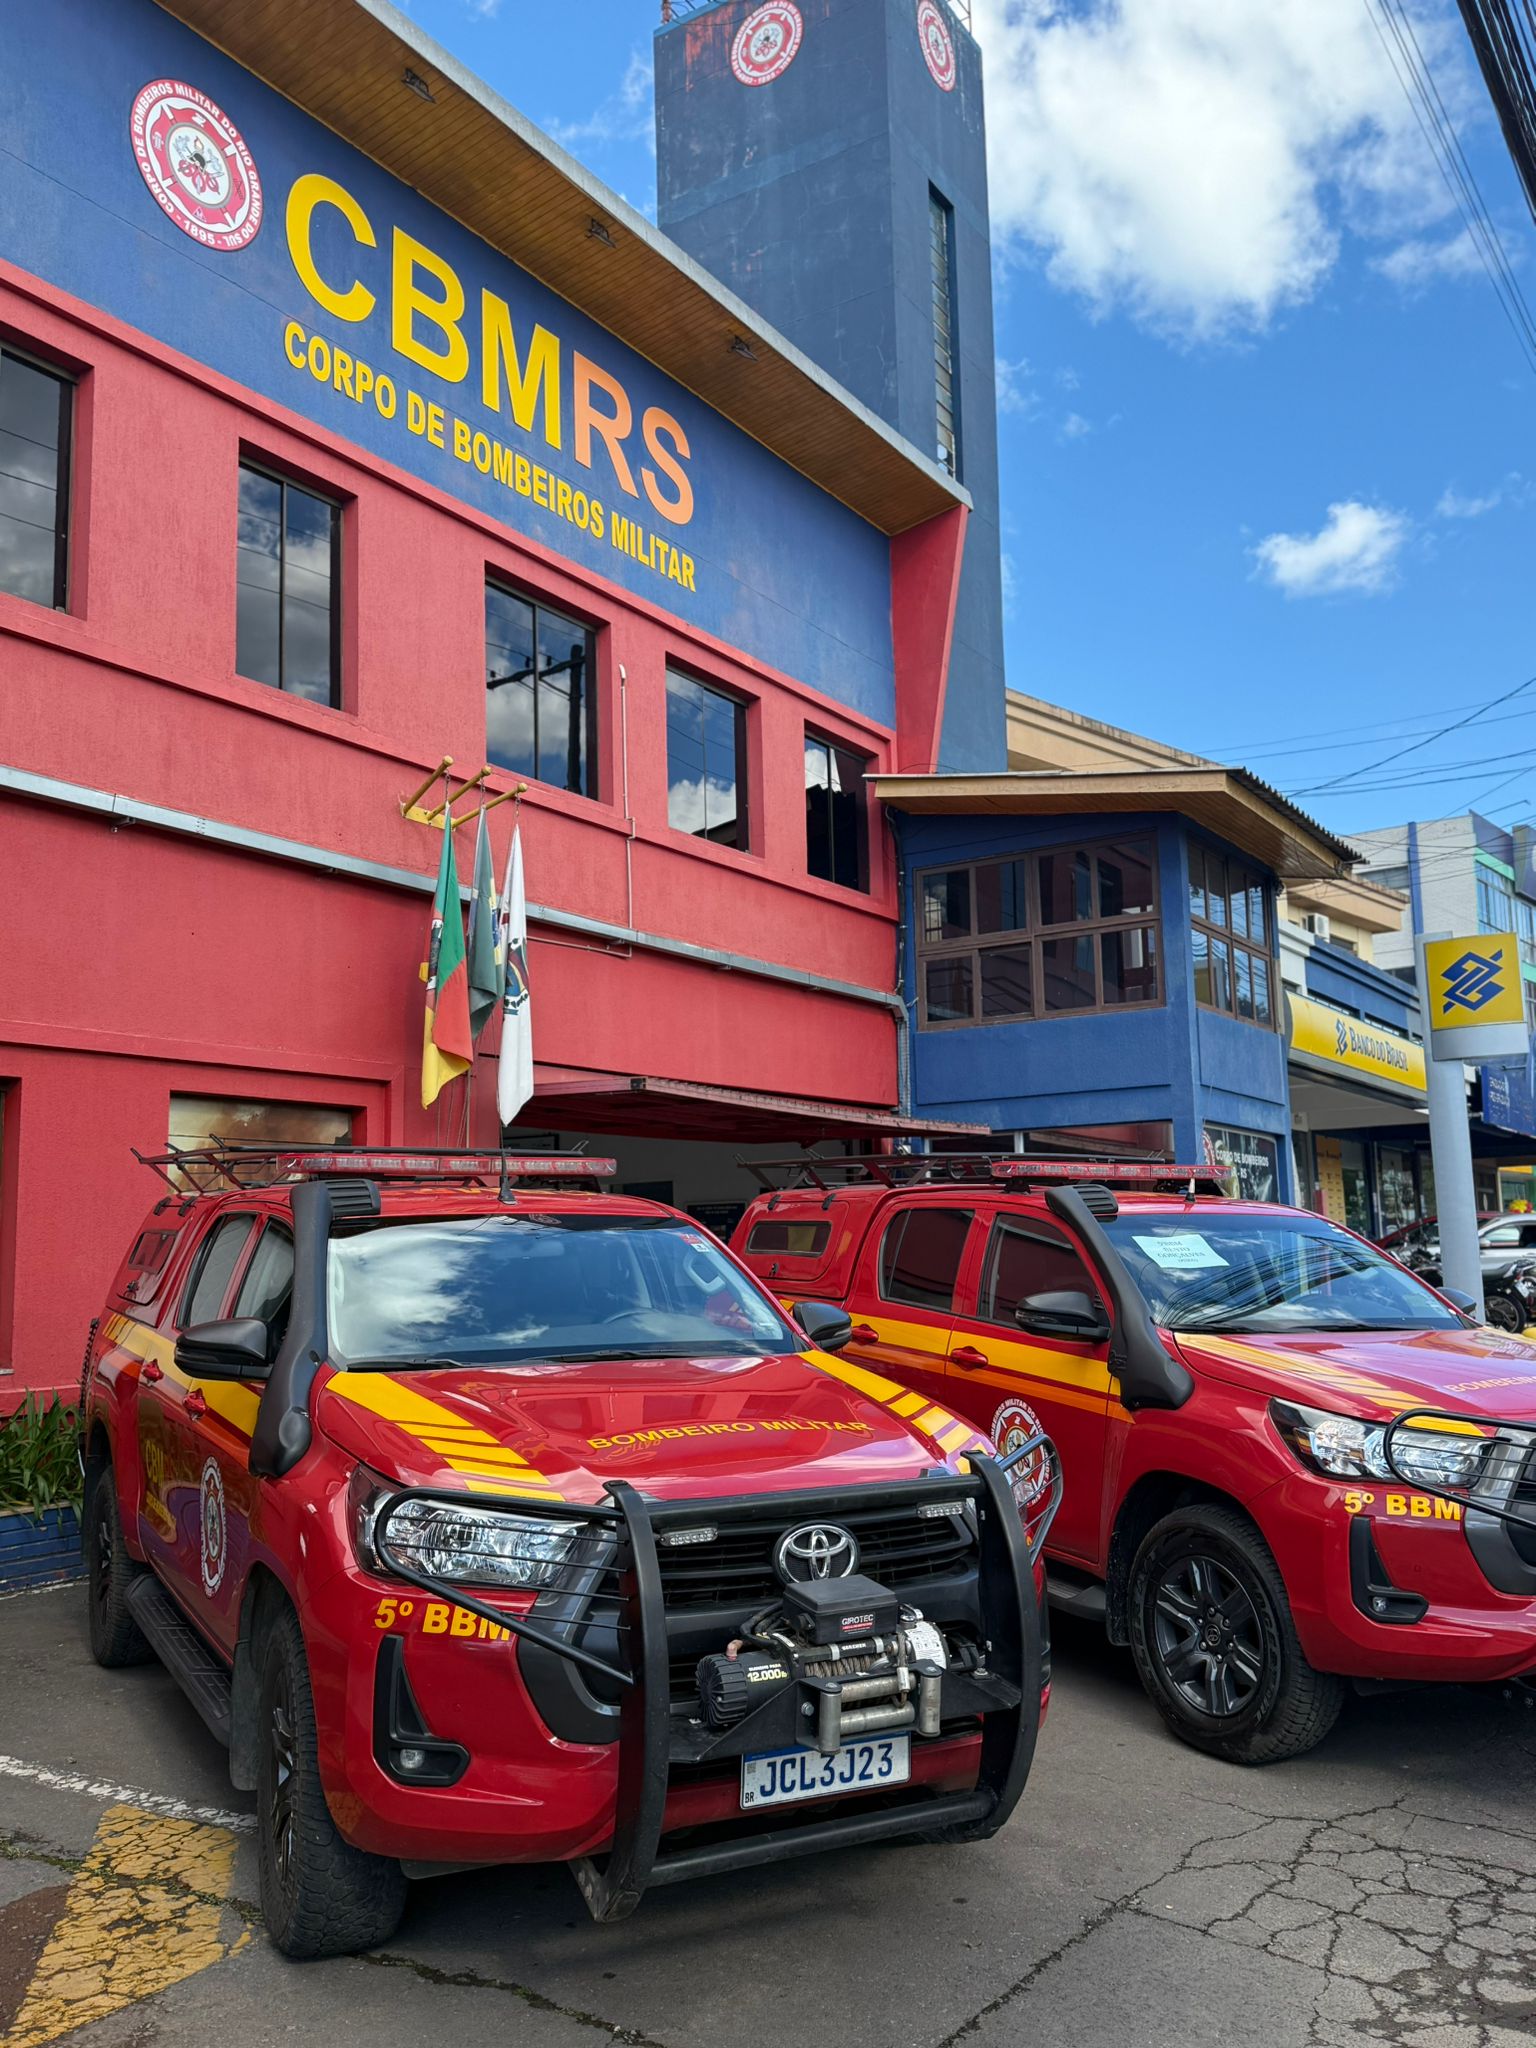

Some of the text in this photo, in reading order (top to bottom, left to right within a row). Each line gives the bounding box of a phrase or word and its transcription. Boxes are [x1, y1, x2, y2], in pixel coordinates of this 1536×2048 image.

[133, 82, 261, 247] CORPO DE BOMBEIROS MILITAR DO RIO GRANDE DO SUL
[183, 220, 215, 245] 1895
[285, 173, 695, 526] CBMRS
[284, 321, 697, 594] CORPO DE BOMBEIROS MILITAR
[587, 1420, 876, 1450] BOMBEIRO MILITAR
[1386, 1494, 1461, 1521] BBM
[422, 1603, 511, 1641] BBM
[759, 1742, 893, 1798] JCL3J23
[744, 1791, 755, 1804] BR
